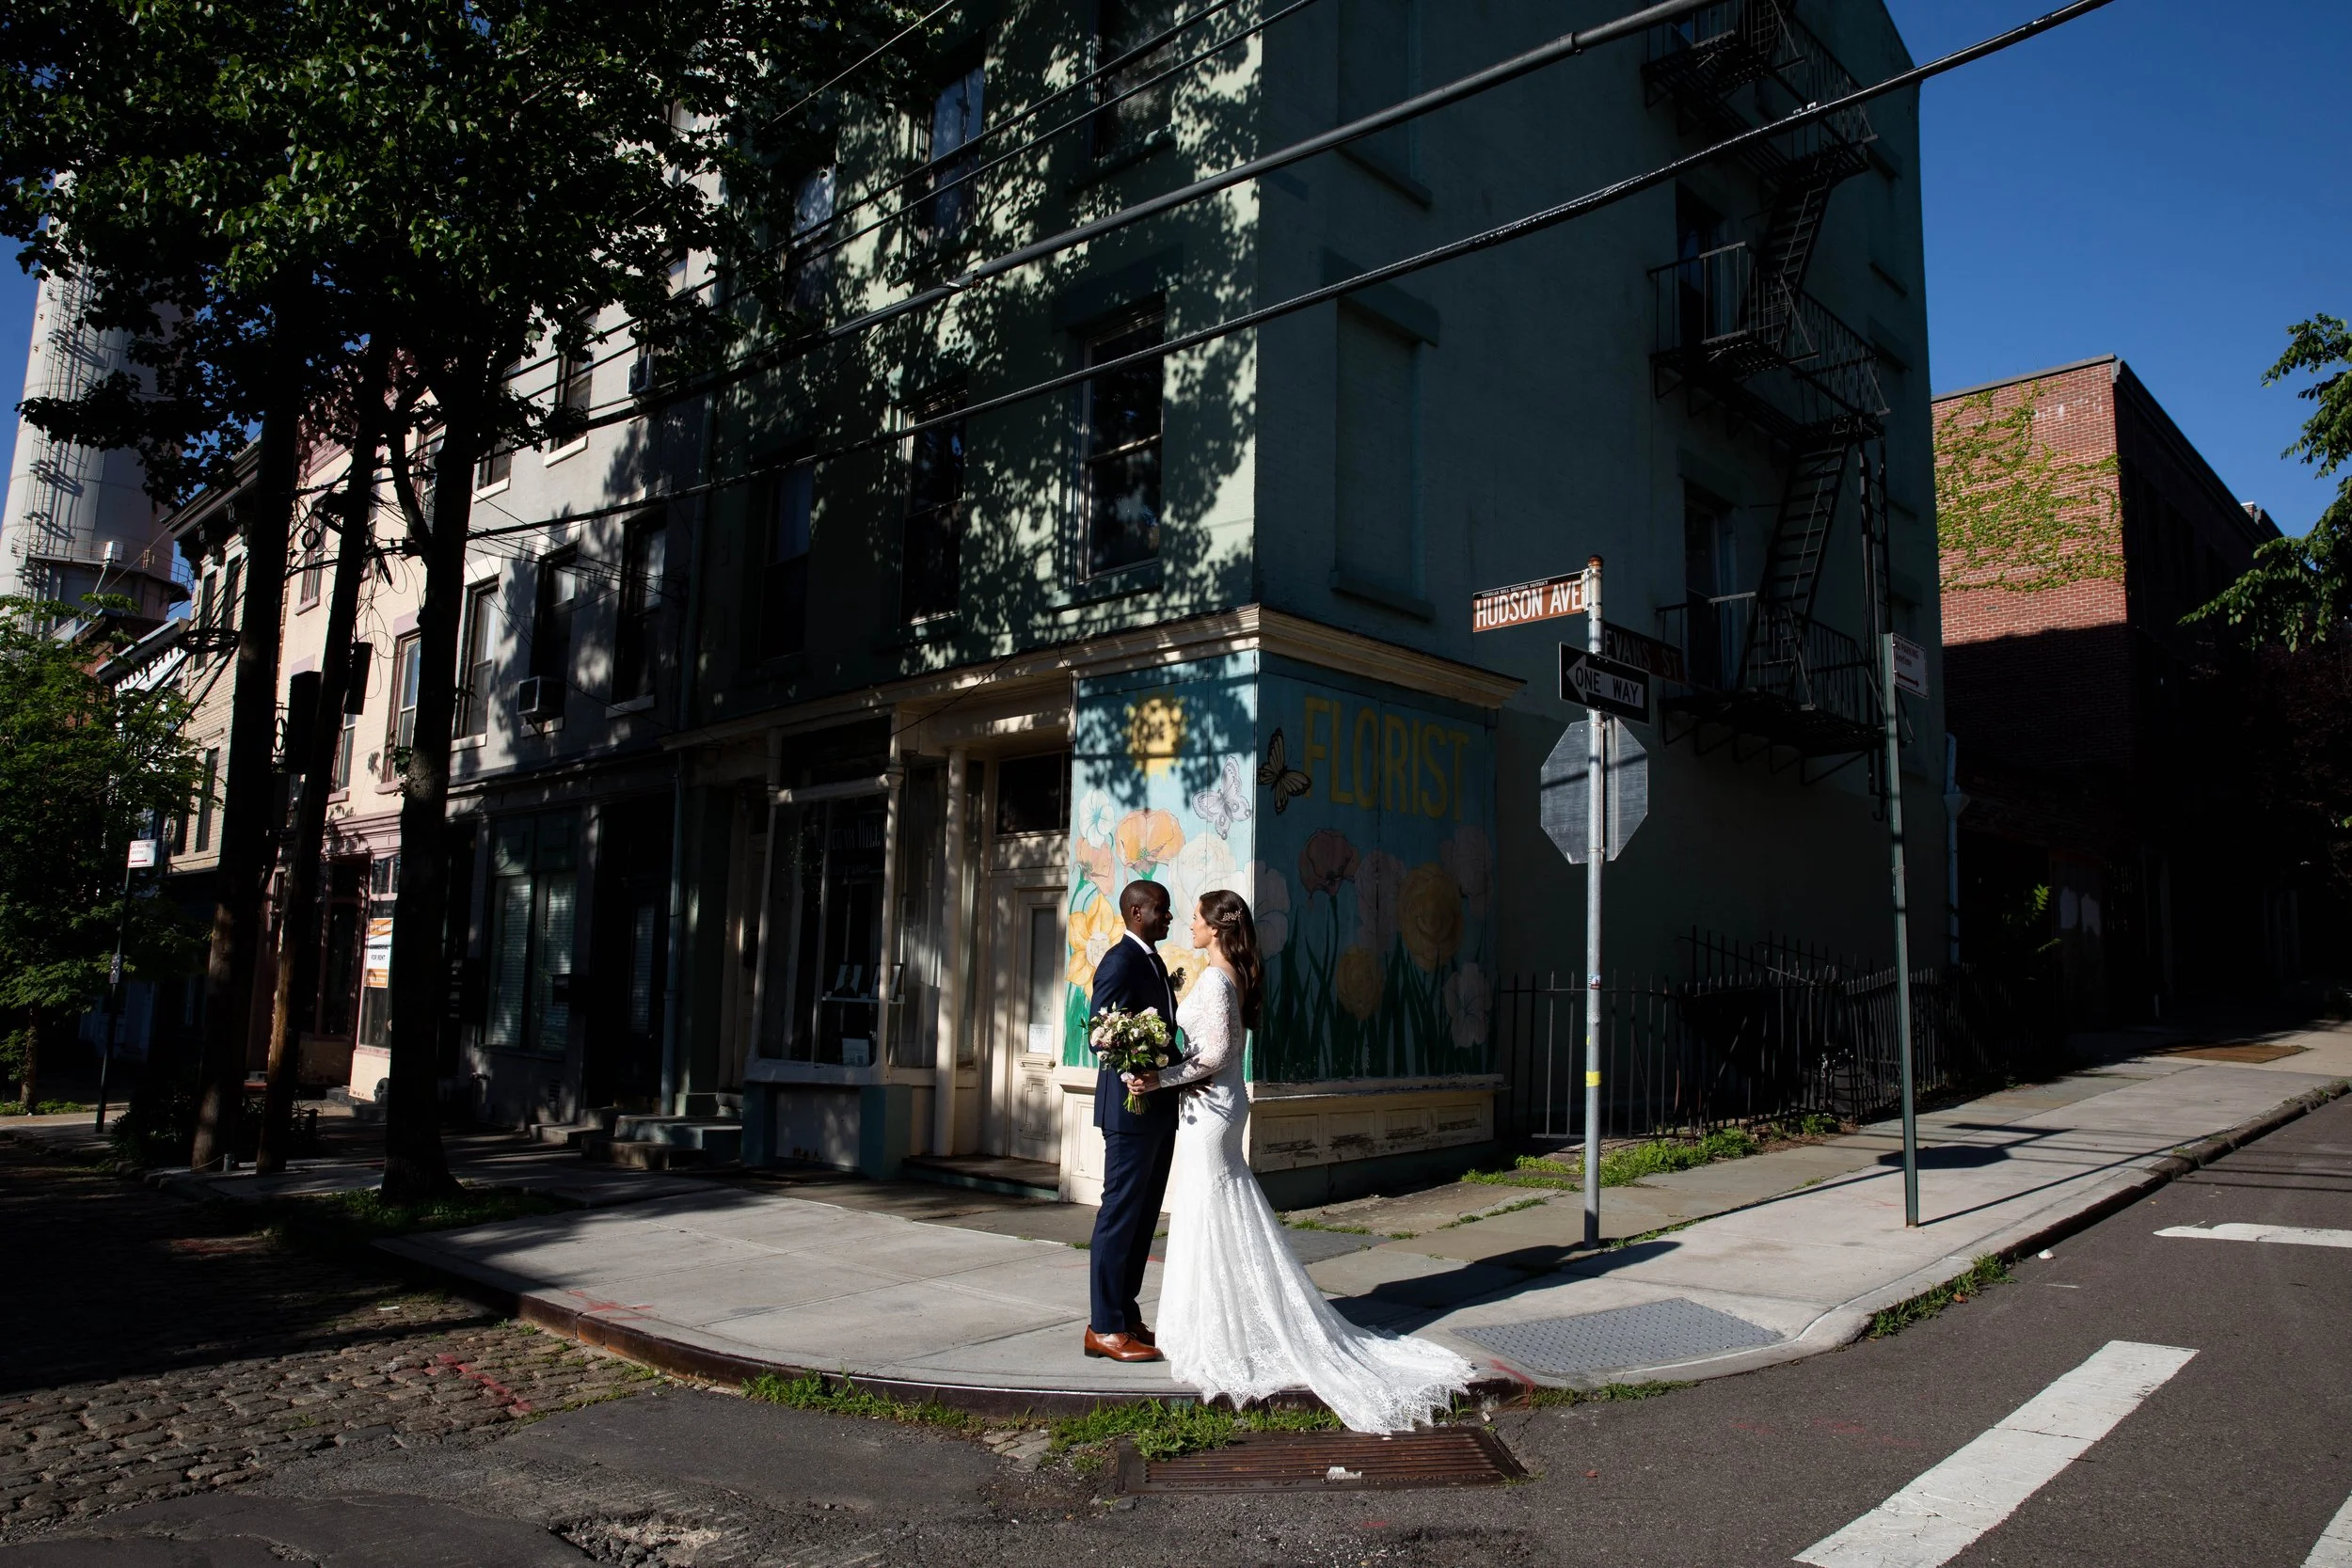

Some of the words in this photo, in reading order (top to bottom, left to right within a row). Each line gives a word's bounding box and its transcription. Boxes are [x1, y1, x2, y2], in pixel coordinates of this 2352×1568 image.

[1476, 588, 1543, 627] HUDSON
[1549, 579, 1581, 614] AVE
[1604, 628, 1651, 670] EVANS
[1661, 647, 1678, 679] ST
[1575, 666, 1601, 694] ONE
[1613, 677, 1638, 705] WAY
[1304, 695, 1470, 821] FLORIST
